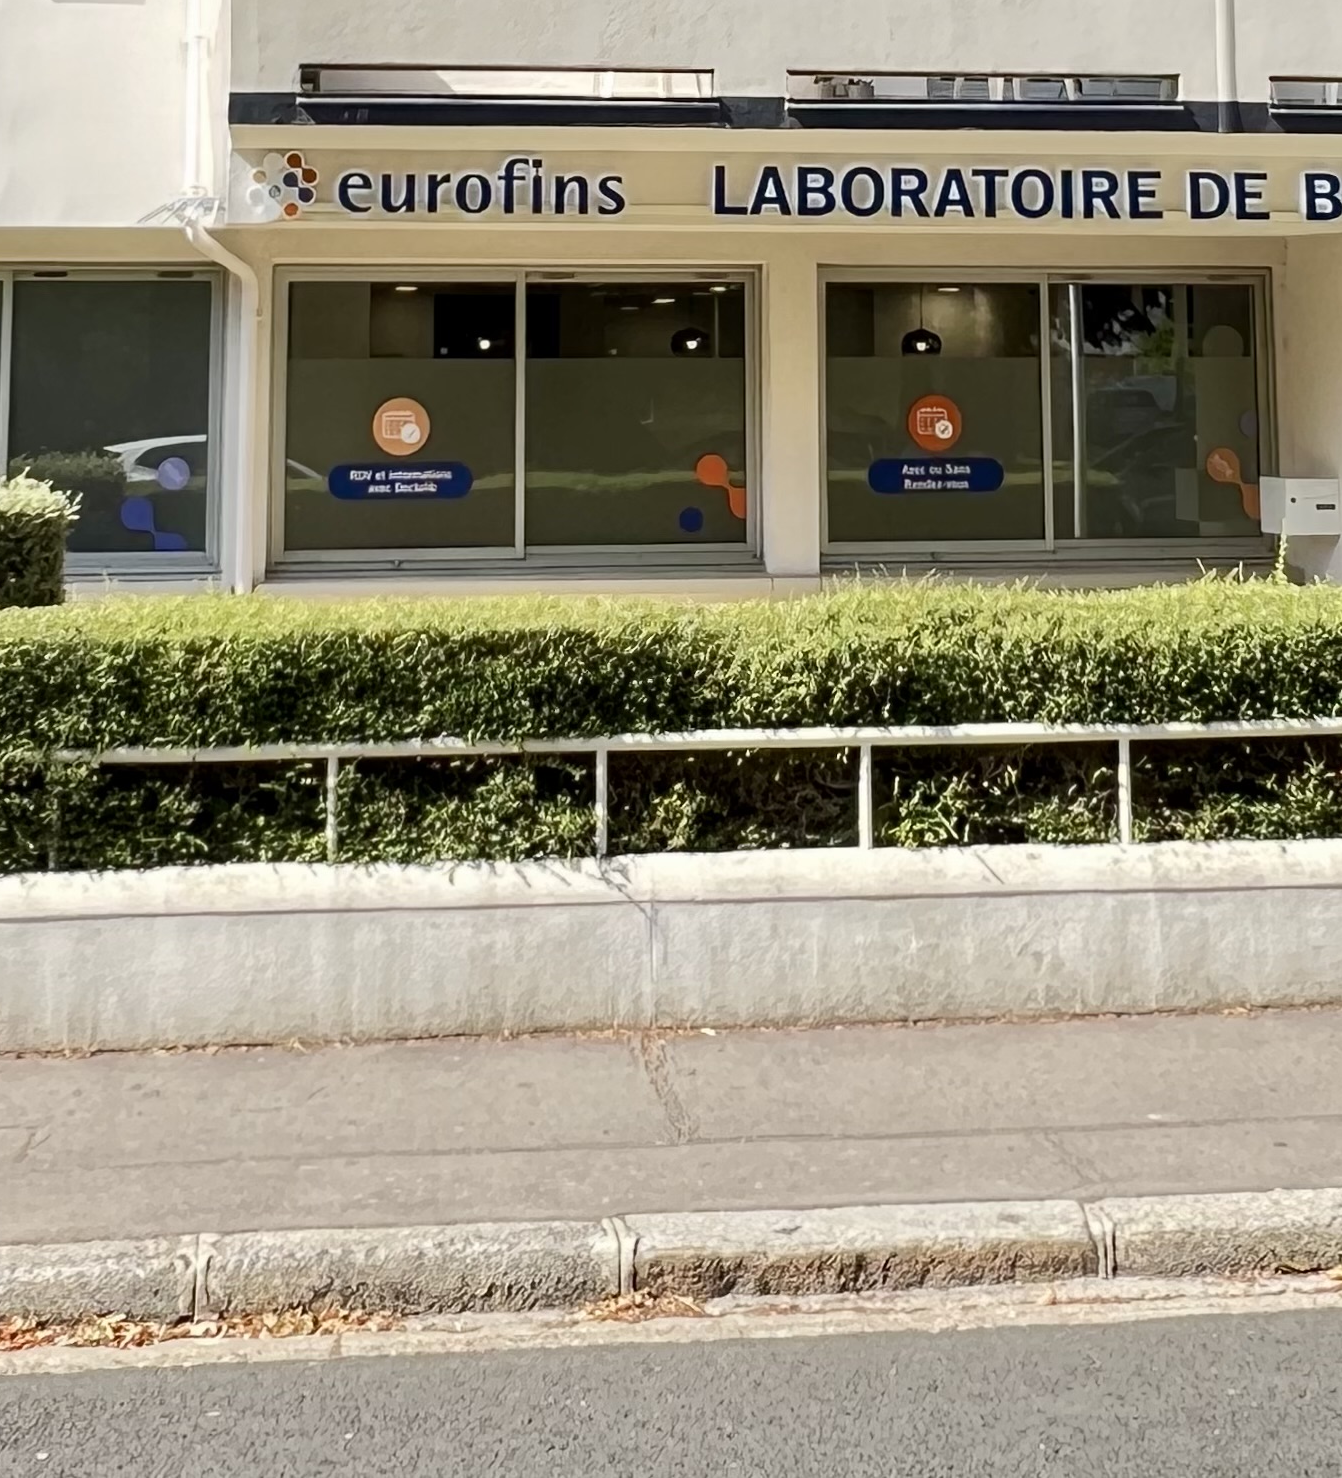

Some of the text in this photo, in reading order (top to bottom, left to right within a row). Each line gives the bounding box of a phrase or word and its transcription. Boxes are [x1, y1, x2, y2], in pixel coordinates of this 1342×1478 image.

[338, 157, 626, 214] eurofins
[713, 165, 1164, 219] LABORATOIRE
[1188, 171, 1270, 220] DE
